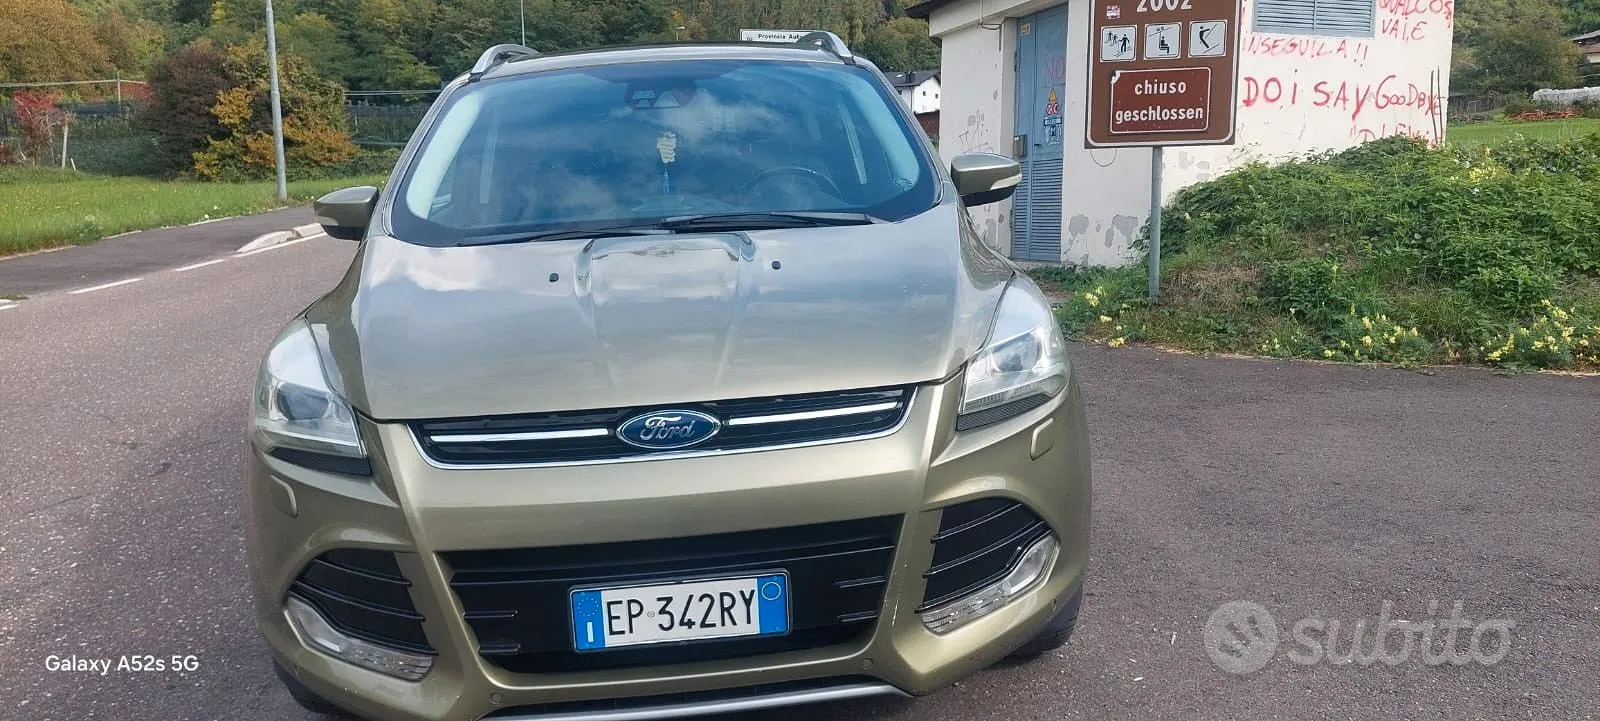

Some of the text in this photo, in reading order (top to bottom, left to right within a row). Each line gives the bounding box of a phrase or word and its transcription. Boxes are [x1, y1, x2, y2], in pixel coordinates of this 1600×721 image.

[1134, 78, 1187, 95] chiuso
[1313, 80, 1371, 120] SAY
[1115, 105, 1204, 124] geschlossen
[639, 415, 696, 441] Ford
[606, 598, 645, 636] EP
[656, 589, 756, 632] 342RY
